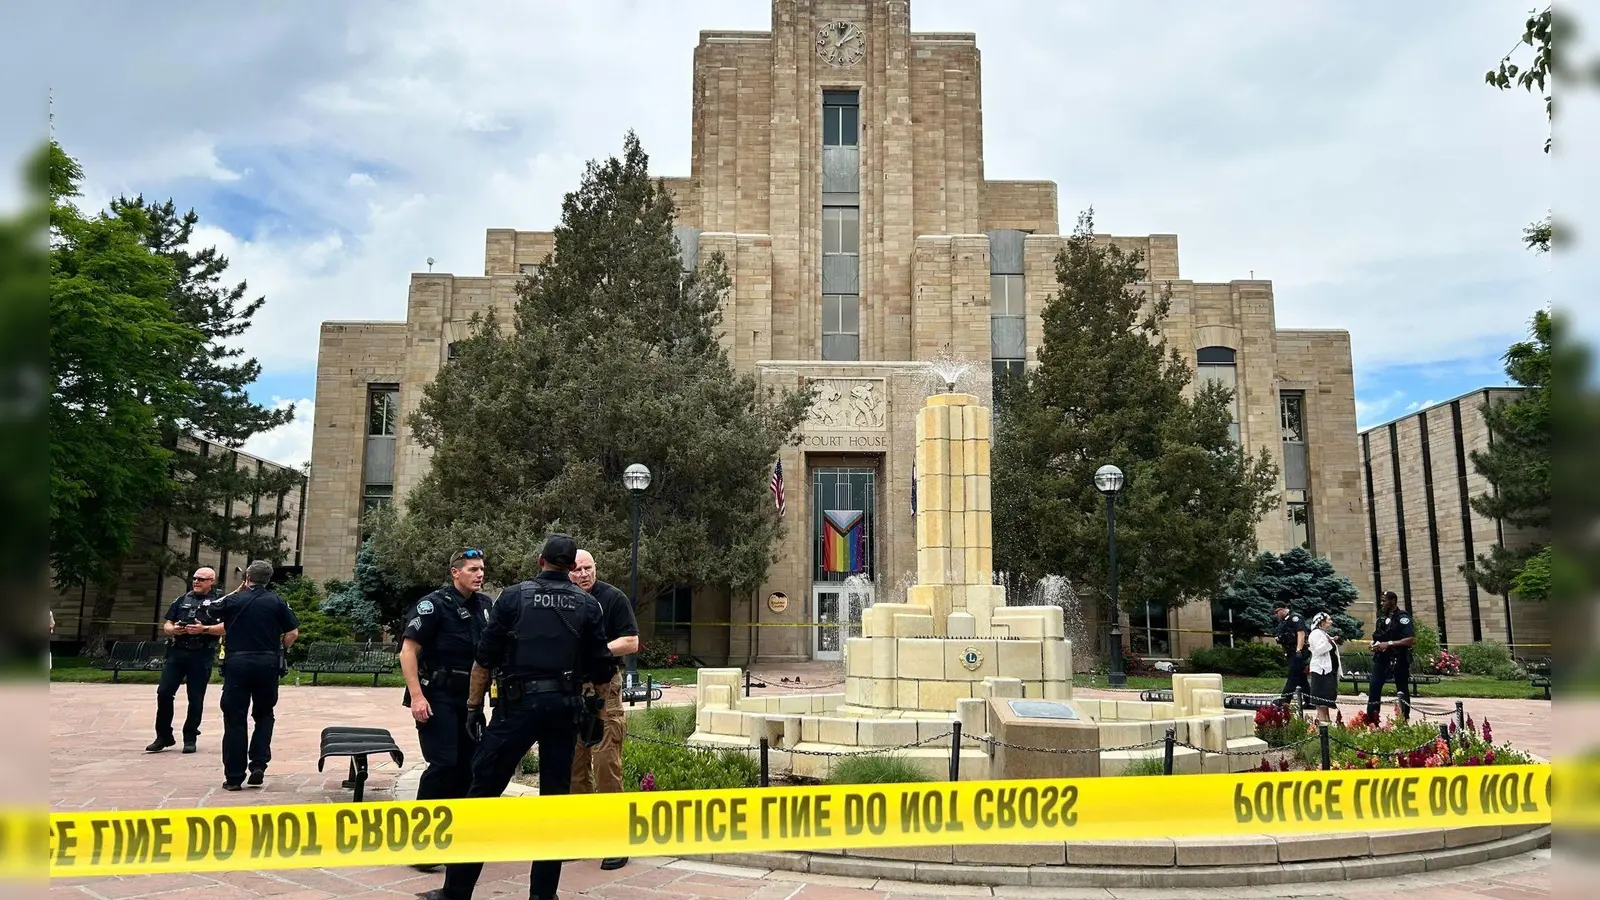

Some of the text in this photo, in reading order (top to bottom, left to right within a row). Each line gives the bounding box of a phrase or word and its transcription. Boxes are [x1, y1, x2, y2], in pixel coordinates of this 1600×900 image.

[804, 436, 887, 446] COURT HOUSE
[534, 594, 575, 608] POLICE
[969, 653, 976, 661] L
